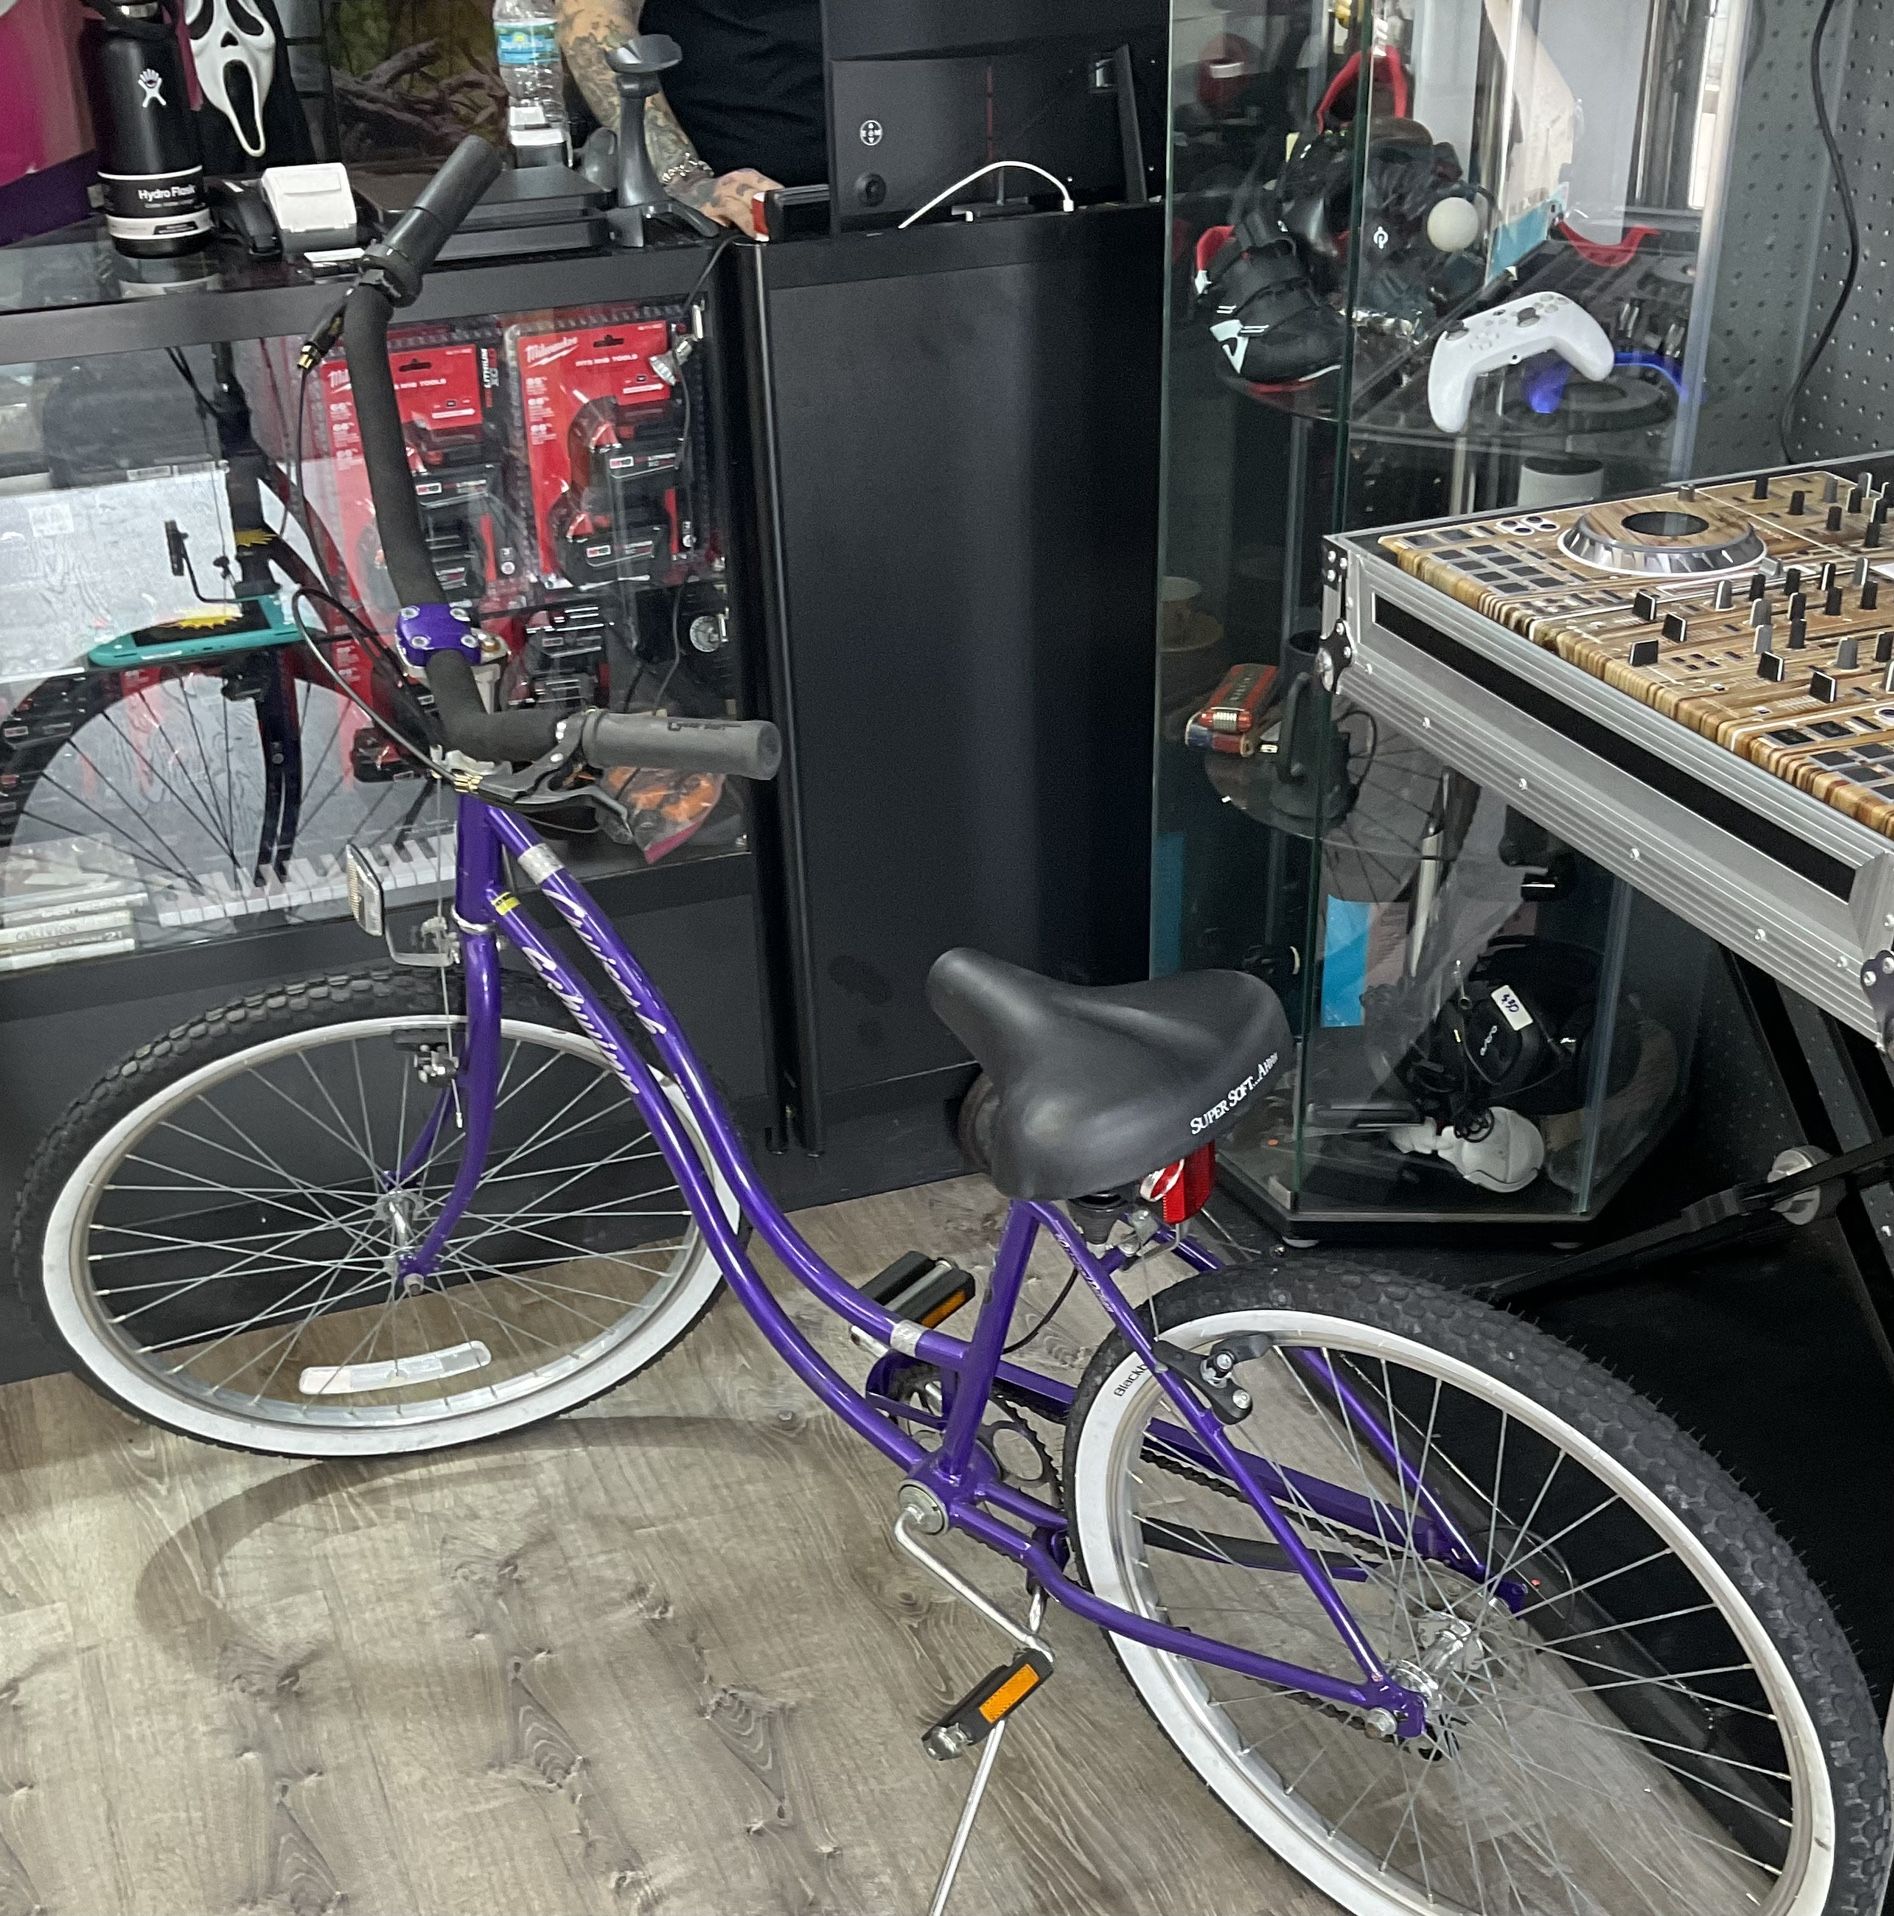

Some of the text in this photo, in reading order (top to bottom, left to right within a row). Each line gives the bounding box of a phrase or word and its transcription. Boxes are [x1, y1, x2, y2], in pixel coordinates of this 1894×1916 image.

[138, 189, 171, 202] Hydro
[522, 946, 640, 1095] Schwinn
[1190, 1099, 1229, 1134] SUPER
